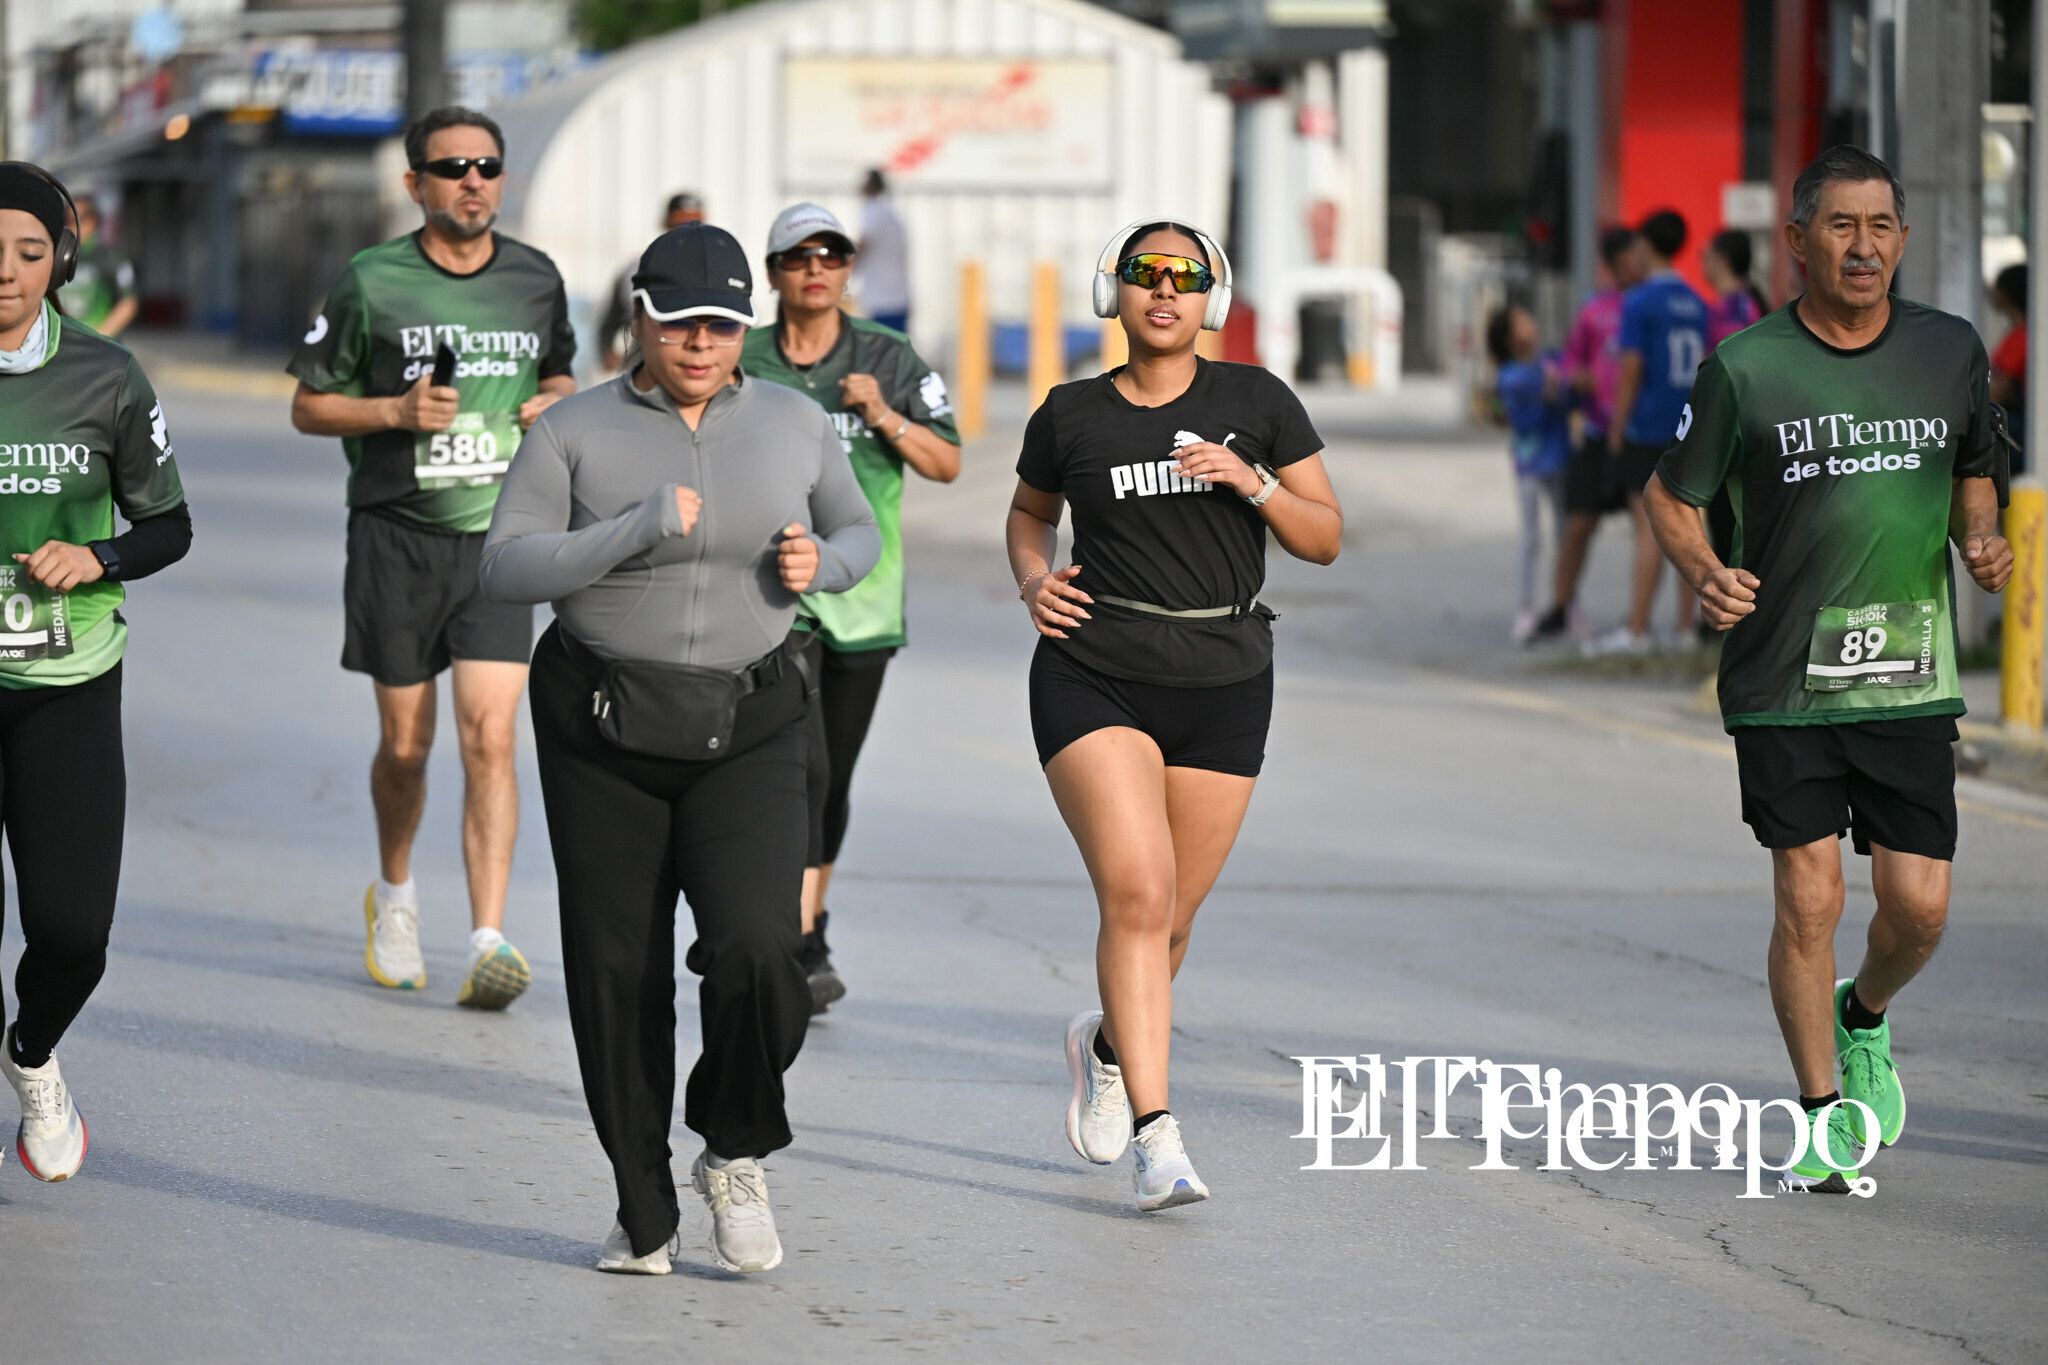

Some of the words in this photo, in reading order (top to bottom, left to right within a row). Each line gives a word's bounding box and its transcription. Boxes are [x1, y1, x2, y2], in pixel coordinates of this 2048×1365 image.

[399, 325, 434, 358] El
[435, 324, 539, 360] Tiempo
[455, 357, 518, 378] odos
[429, 431, 497, 466] 580
[1774, 418, 1816, 456] El
[1818, 413, 1948, 449] Tiempo
[1783, 461, 1820, 483] de
[1826, 451, 1921, 476] todos
[51, 594, 67, 646] MEDALL
[1922, 605, 1932, 613] 89
[1840, 626, 1888, 664] 89
[1920, 618, 1932, 674] MEDALLA
